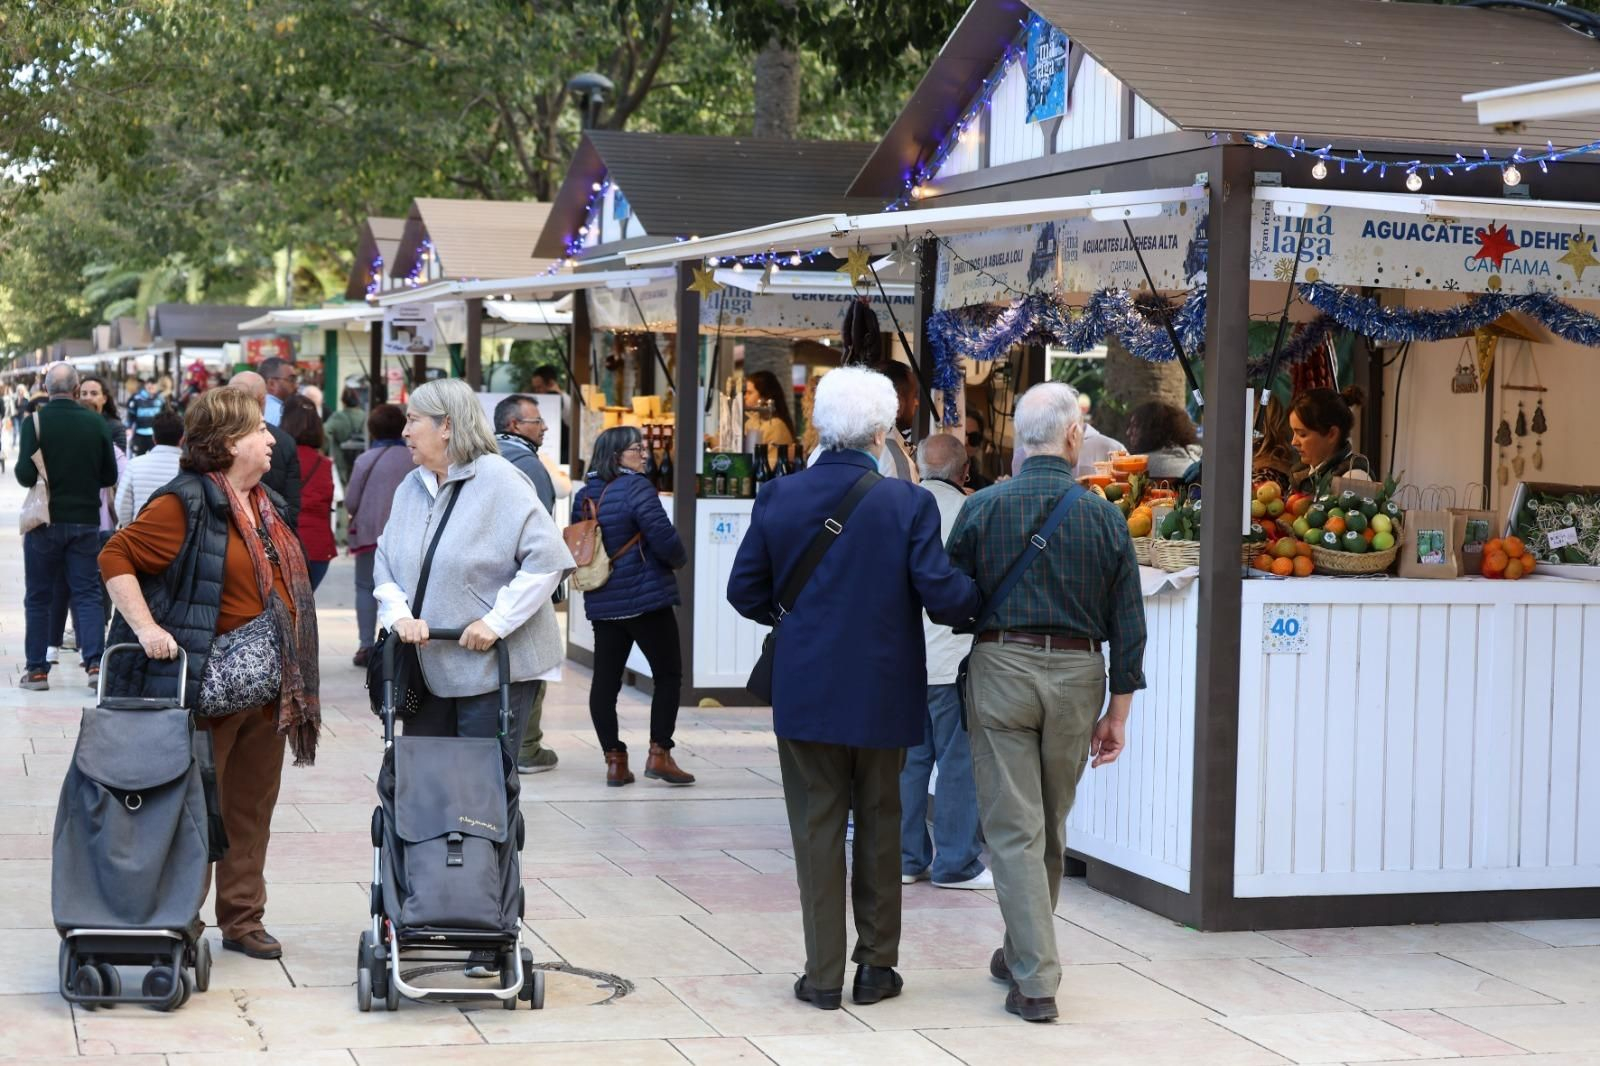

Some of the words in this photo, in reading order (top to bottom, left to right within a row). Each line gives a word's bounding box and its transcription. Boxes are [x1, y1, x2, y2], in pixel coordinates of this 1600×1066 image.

[1283, 205, 1335, 236] má
[1361, 219, 1487, 246] AGUACATES
[1082, 239, 1120, 254] AGUACATES
[1120, 239, 1129, 252] LA
[1130, 236, 1157, 251] DEHESA
[1158, 235, 1179, 249] ALTA
[1272, 225, 1333, 263] laga
[1010, 249, 1024, 263] LOLI
[716, 522, 732, 533] 41
[1270, 618, 1299, 636] 40
